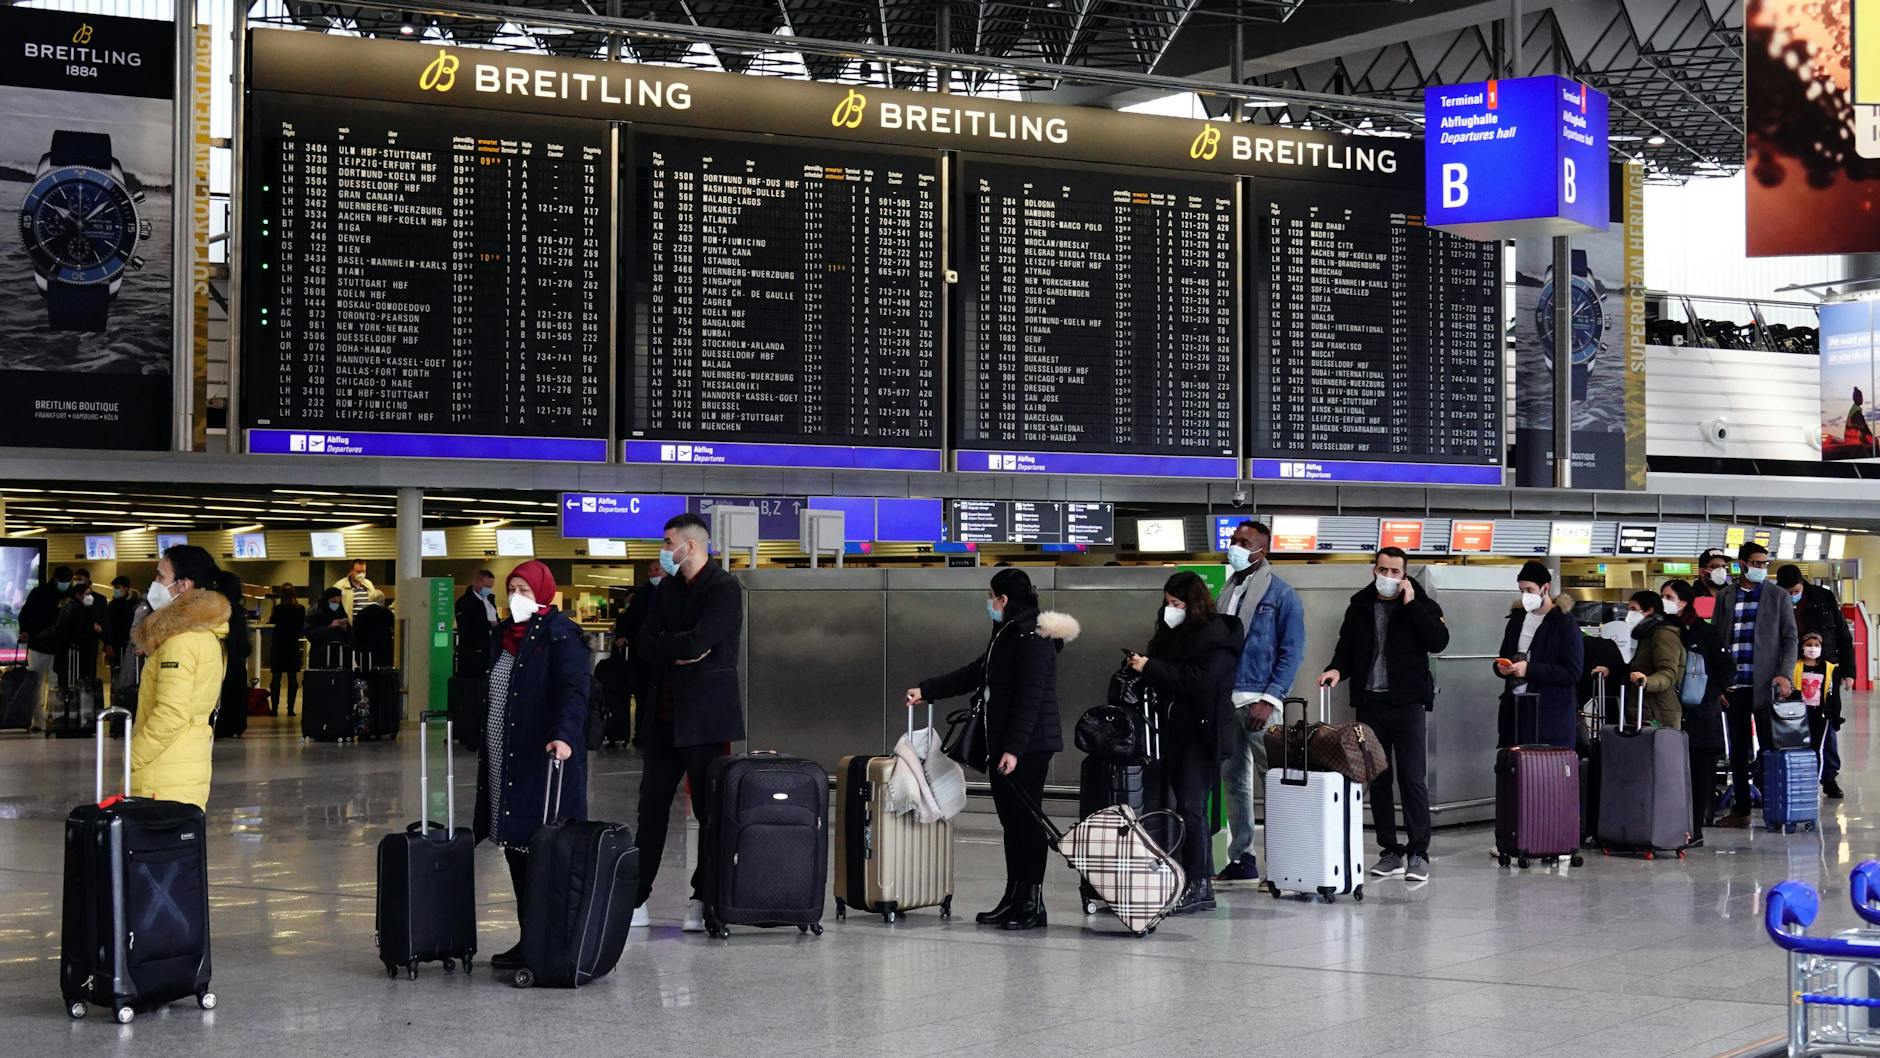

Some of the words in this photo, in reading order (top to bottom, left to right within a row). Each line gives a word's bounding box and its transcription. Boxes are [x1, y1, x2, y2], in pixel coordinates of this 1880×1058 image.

[24, 42, 142, 66] BREITLING
[66, 64, 98, 78] 1884
[475, 64, 692, 110] BREITLING
[1440, 93, 1483, 108] Terminal
[1489, 92, 1495, 103] 1
[1563, 88, 1580, 106] Terminal
[880, 102, 1068, 144] BREITLING
[1440, 113, 1498, 128] Abflughalle
[1563, 110, 1586, 128] Abflughalle
[1440, 128, 1494, 144] Departures
[1496, 126, 1517, 139] hall
[1563, 126, 1585, 144] Departures
[306, 143, 327, 153] 3404
[339, 146, 355, 155] ULM
[361, 148, 432, 161] HBF-STUTTGART
[1232, 136, 1397, 174] BREITLING
[339, 157, 416, 171] LEIPZIG-ERFURT
[421, 163, 437, 172] HBF
[338, 168, 416, 182] DORTMUND-KOELN
[421, 174, 437, 183] HBF
[703, 174, 742, 185] DORTMUND
[746, 178, 781, 188] HBF-DUS
[784, 180, 799, 188] HBF
[1564, 158, 1576, 204] B
[338, 179, 399, 191] DUESSELDORF
[404, 184, 420, 192] HBF
[1442, 162, 1469, 208] B
[306, 188, 327, 197] 1502
[338, 190, 361, 199] GRAN
[366, 192, 405, 202] CANARIA
[538, 204, 574, 214] 121-276
[584, 207, 599, 216] A17
[702, 184, 785, 198] WASHINGTON-DULLES
[919, 201, 934, 210] Z20
[702, 195, 761, 206] MALABO-LAGOS
[338, 201, 442, 216] NUERNBERG-WUERZBURG
[678, 203, 693, 212] 302
[702, 205, 742, 215] BUKAREST
[1628, 164, 1644, 249] HERITAGE
[338, 212, 371, 222] AACHEN
[377, 215, 426, 225] HBF-KOELN
[431, 218, 447, 227] HBF
[702, 215, 737, 224] ATLANTA
[338, 223, 361, 232] RIGA
[310, 232, 327, 241] 446
[338, 234, 371, 244] DENVER
[702, 226, 727, 234] MALTA
[879, 237, 910, 247] 733-751
[702, 236, 766, 248] ROM-FIUMICINO
[337, 245, 360, 254] WIEN
[702, 246, 727, 255] PUNTA
[732, 248, 752, 256] CANA
[338, 256, 447, 270] BASEL-MANNHEIM-KARLS
[703, 257, 741, 266] ISTANBUL
[337, 267, 364, 276] MIAMI
[337, 278, 387, 288] STUTTGART
[392, 281, 408, 290] HBF
[702, 277, 742, 287] SINGAPUR
[337, 289, 365, 298] KOELN
[370, 291, 386, 300] HBF
[702, 287, 727, 296] PARIS
[731, 289, 745, 297] CH.
[750, 290, 760, 298] DE
[765, 291, 794, 300] GAULLE
[337, 300, 430, 313] MOSKAU-DOMODEDOVO
[702, 298, 732, 307] ZAGREB
[337, 311, 420, 323] TORONTO-PEARSON
[702, 308, 727, 317] KOELN
[1630, 253, 1646, 372] SUPEROCEAN
[336, 322, 353, 330] NEW
[359, 323, 419, 334] YORK-NEWARK
[702, 319, 745, 328] BANGALORE
[336, 333, 397, 344] DUESSELDORF
[403, 336, 418, 345] HBF
[702, 329, 731, 337] MUMBAI
[336, 344, 392, 354] DOHA-HAMAD
[702, 339, 785, 351] STOCKHOLM-ARLANDA
[336, 355, 446, 368] HANNOVER-KASSEL-GOET
[702, 360, 731, 369] MALAGA
[336, 366, 396, 376] DALLAS-FORT
[402, 369, 430, 377] WORTH
[336, 377, 386, 387] CHICAGO-O
[391, 380, 412, 388] HARE
[702, 380, 759, 390] THESSALONIKI
[358, 389, 429, 399] HBF-STUTTGART
[35, 400, 77, 410] BREITLING
[79, 402, 119, 412] BOUTIQUE
[336, 399, 408, 410] ROM-FIUMICINO
[702, 401, 740, 410] BRUESSEL
[336, 410, 412, 420] LEIPZIG-ERFURT
[418, 413, 434, 422] HBF
[702, 422, 741, 431] MUENCHEN
[327, 436, 350, 445] Abflug
[327, 445, 363, 454] Departures
[693, 446, 714, 454] Abflug
[693, 454, 725, 462] Departures
[597, 505, 628, 514] Departures
[598, 498, 617, 506] Abflug
[630, 497, 640, 514] C
